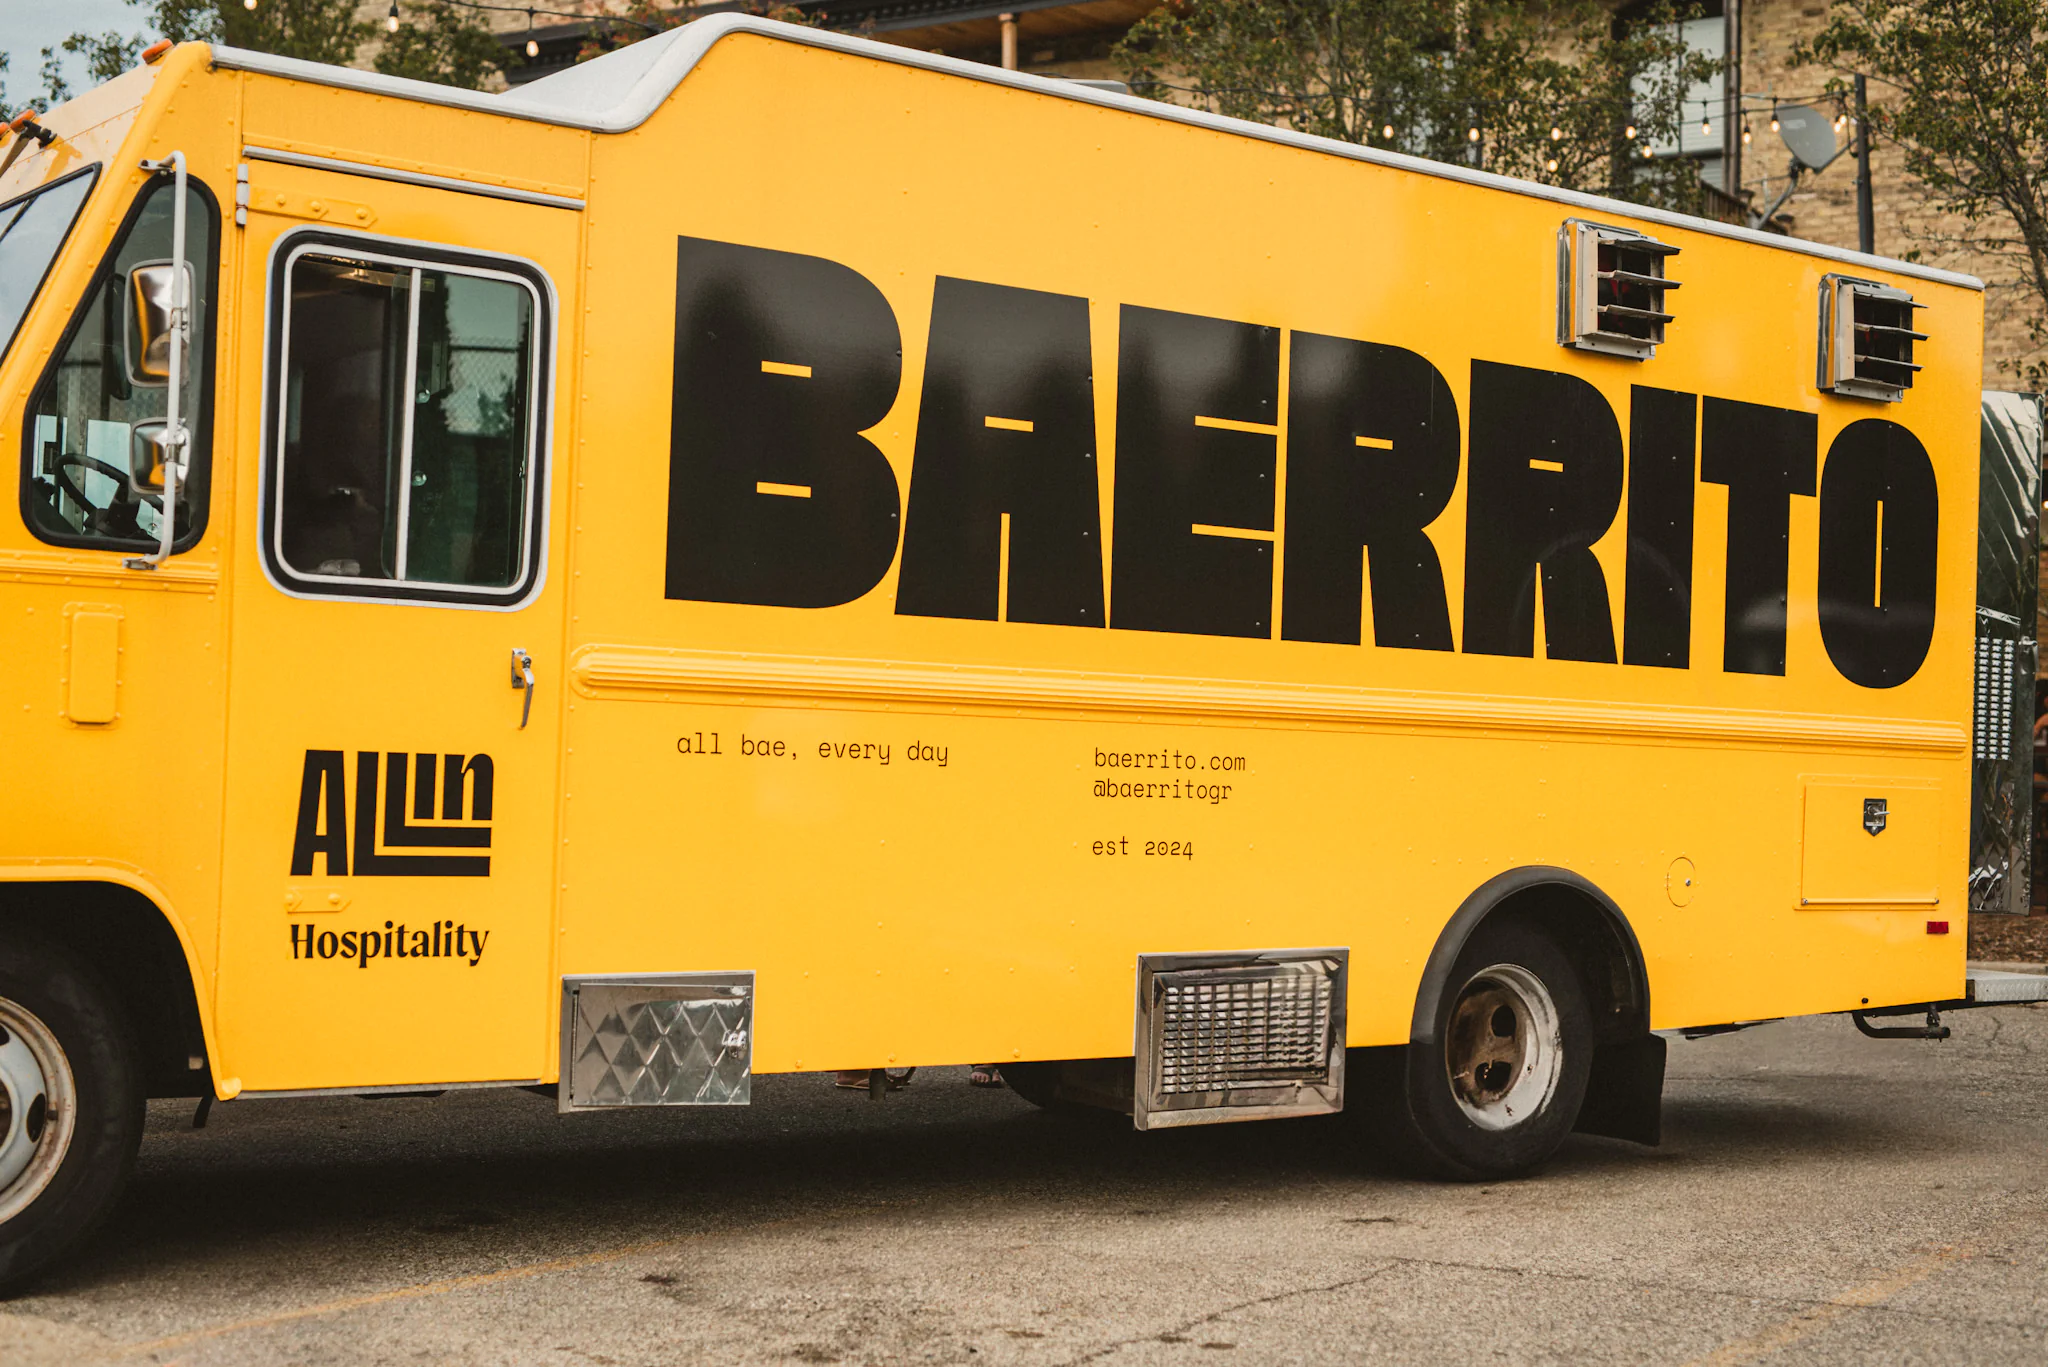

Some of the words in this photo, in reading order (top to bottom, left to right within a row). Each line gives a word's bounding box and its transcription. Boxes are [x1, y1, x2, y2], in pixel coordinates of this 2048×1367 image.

[665, 236, 1937, 689] BAERRITO
[677, 732, 722, 755] all
[741, 734, 798, 760] bae,
[818, 742, 890, 766] every
[907, 740, 949, 767] day
[1094, 747, 1246, 771] baerrito.com
[1093, 777, 1232, 804] @baerritogr
[1092, 836, 1128, 856] est
[1144, 841, 1194, 861] 2024
[290, 920, 490, 968] Hospitality
